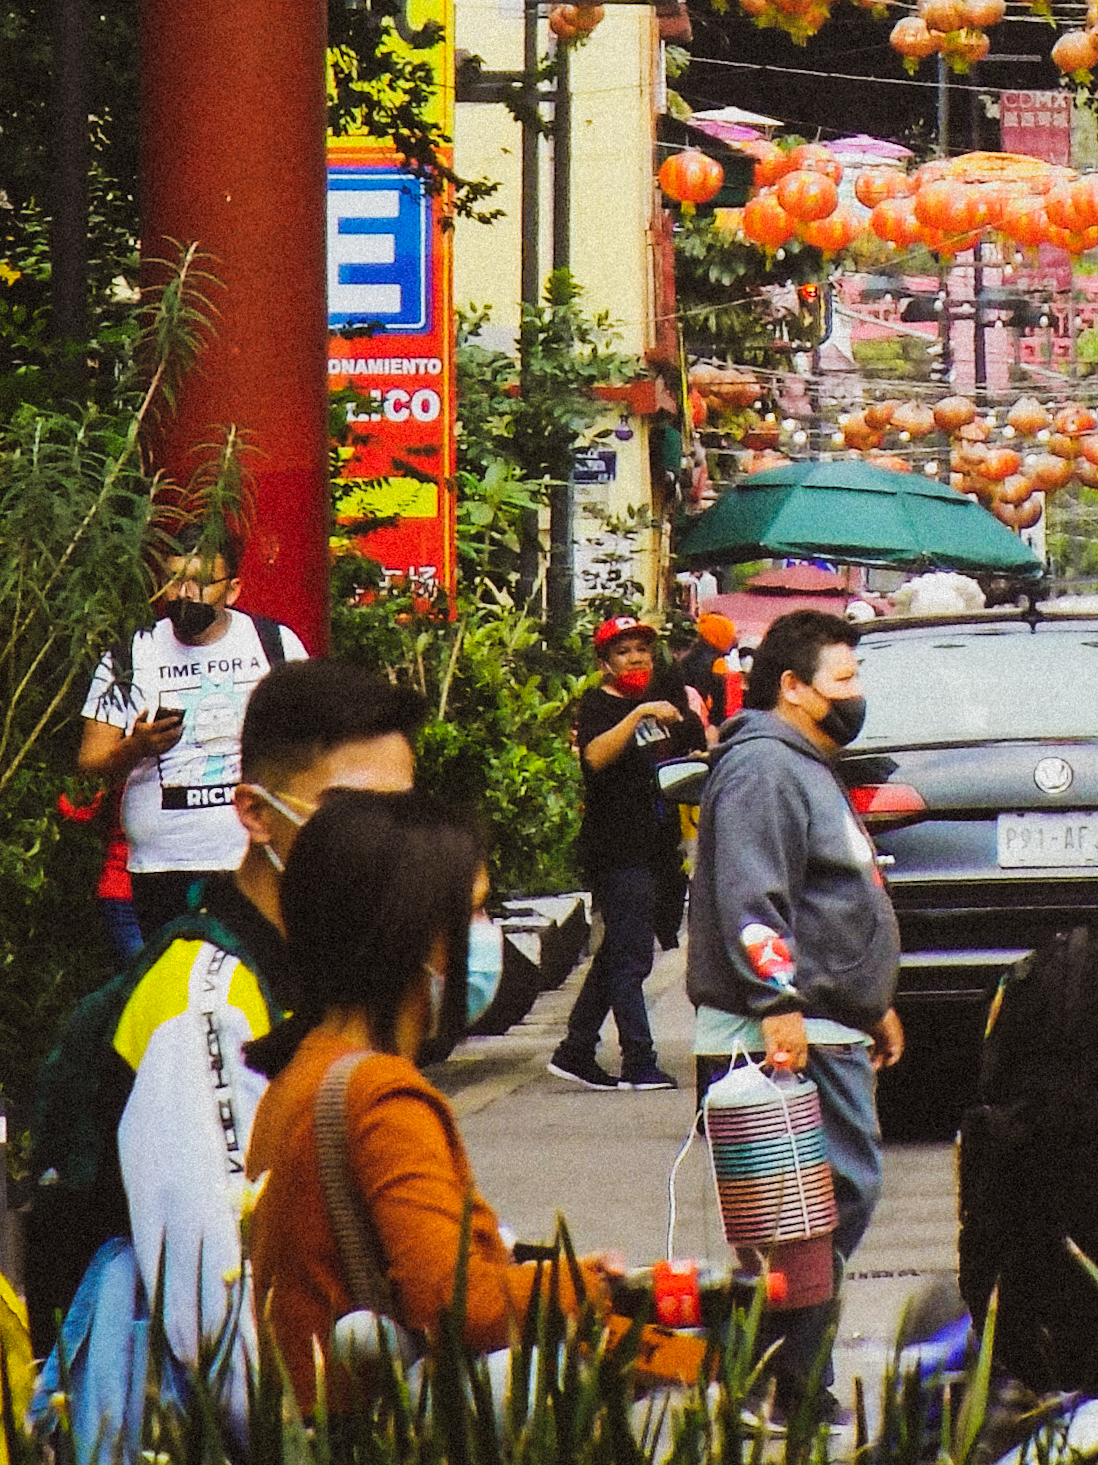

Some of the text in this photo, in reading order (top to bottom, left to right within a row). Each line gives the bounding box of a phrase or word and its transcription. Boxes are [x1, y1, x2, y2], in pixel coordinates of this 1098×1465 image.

[1002, 91, 1068, 108] CDMX
[158, 656, 261, 680] TIME FOR A
